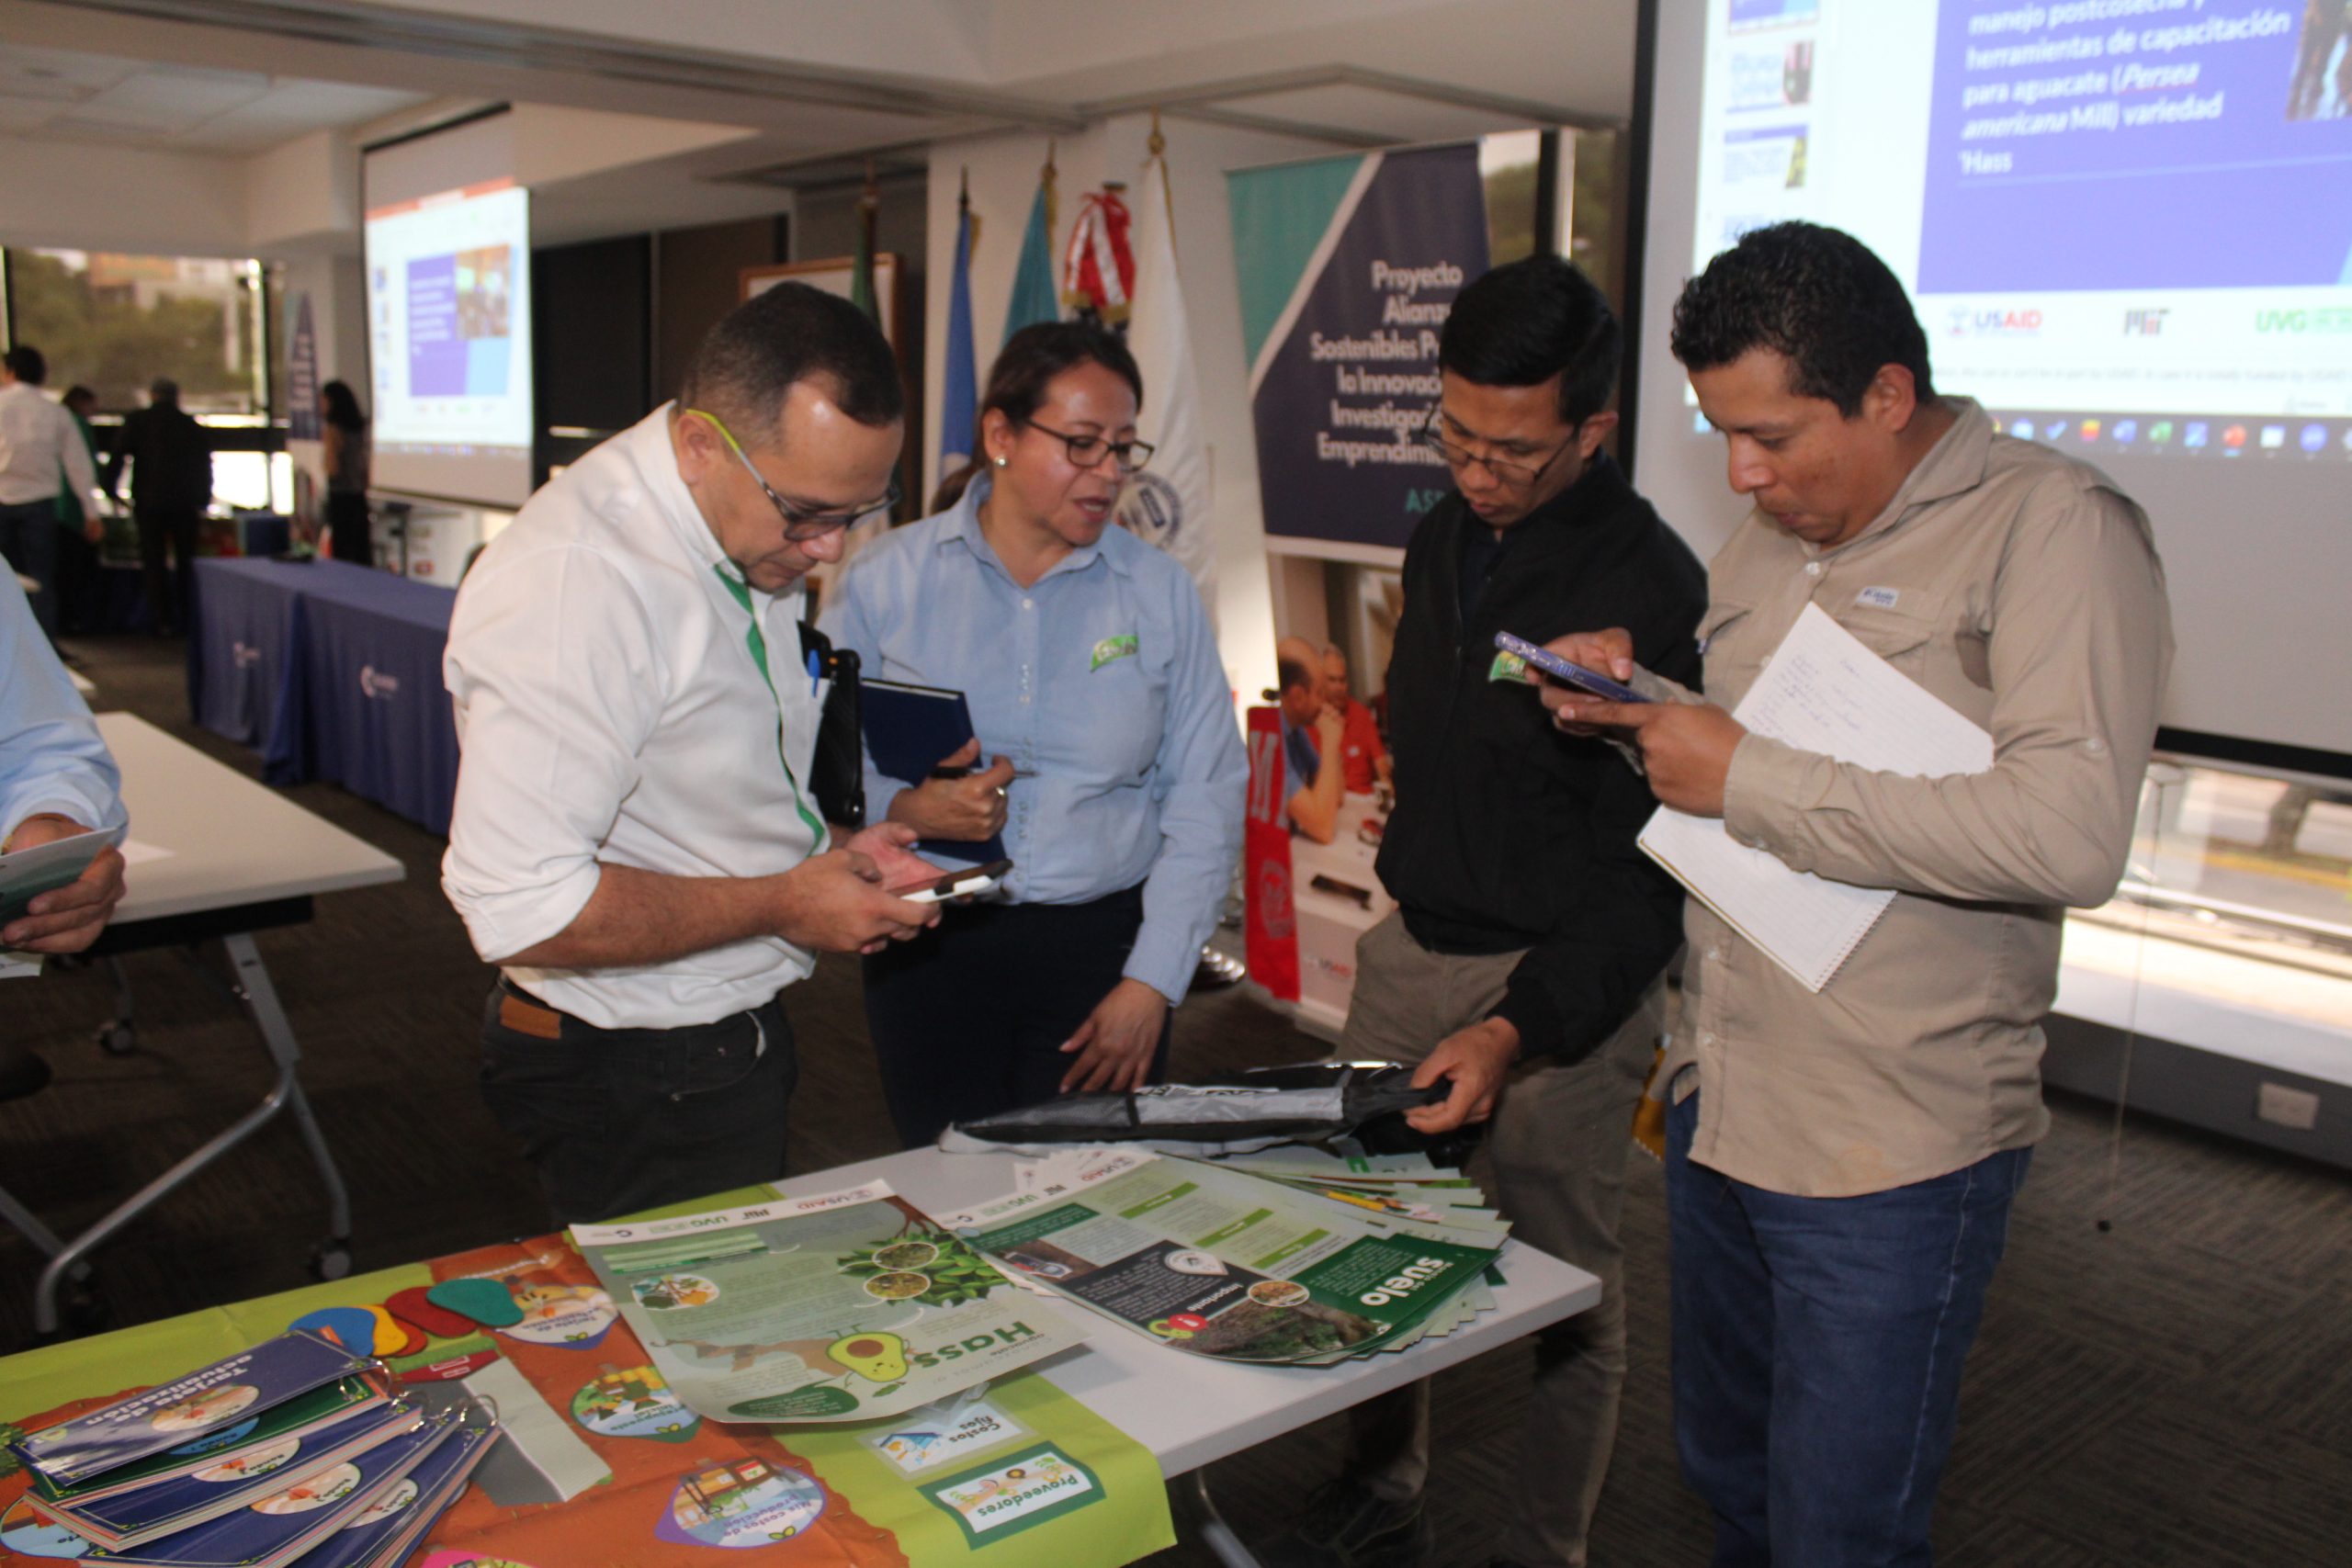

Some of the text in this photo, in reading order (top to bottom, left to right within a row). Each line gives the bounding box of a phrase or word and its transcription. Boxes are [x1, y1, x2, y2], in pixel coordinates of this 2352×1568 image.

[1969, 7, 2045, 35] manejo
[1965, 10, 2291, 71] herramientas de capacitación
[1962, 62, 2200, 109] para aguacate (Persea
[1961, 111, 2067, 140] americana
[2122, 91, 2224, 127] variedad
[1372, 260, 1464, 295] Proyecto
[1384, 295, 1452, 325] Alianz
[1974, 309, 2043, 329] USAID
[1310, 331, 1419, 361] Sostenibles
[1337, 366, 1358, 395] la
[1361, 1256, 1444, 1306] suelo
[913, 1321, 1035, 1369] Hass
[115, 1367, 249, 1422] Tarjeta de
[948, 1422, 1001, 1443] Costos
[959, 1416, 994, 1430] fijos
[978, 1474, 1080, 1517] Proveedores
[723, 1501, 812, 1537] Mis costos de
